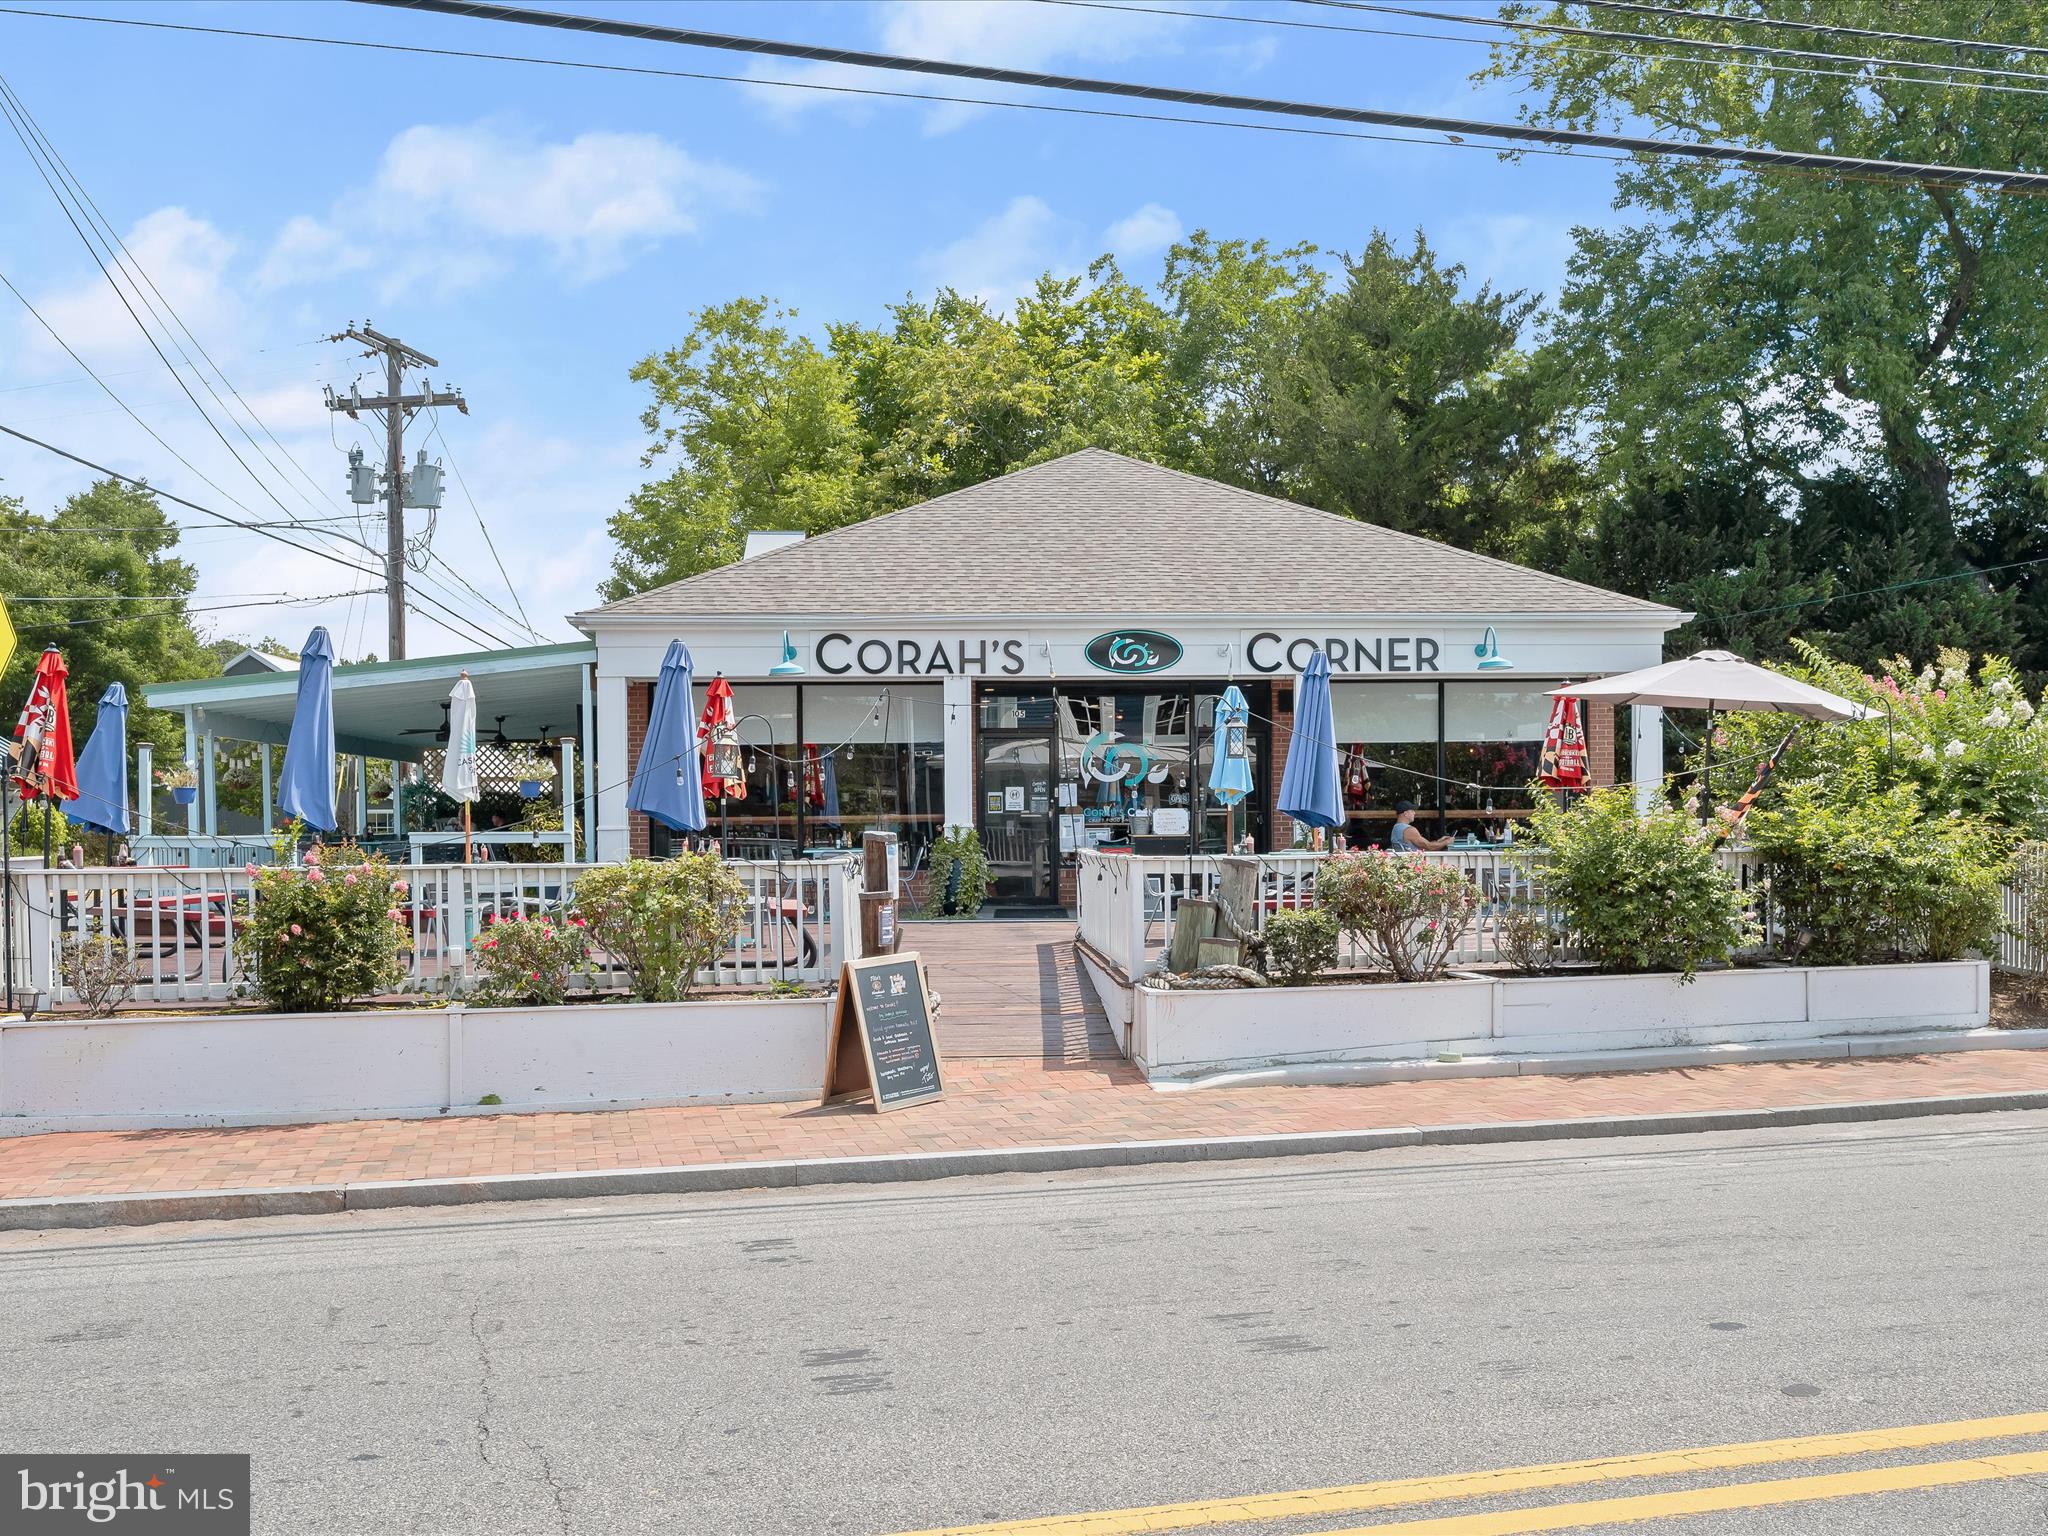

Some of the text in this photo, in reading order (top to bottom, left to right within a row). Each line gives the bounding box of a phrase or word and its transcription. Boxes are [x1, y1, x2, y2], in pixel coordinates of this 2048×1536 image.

[815, 632, 1440, 675] CORAH'S CORNER
[1011, 710, 1025, 718] 105
